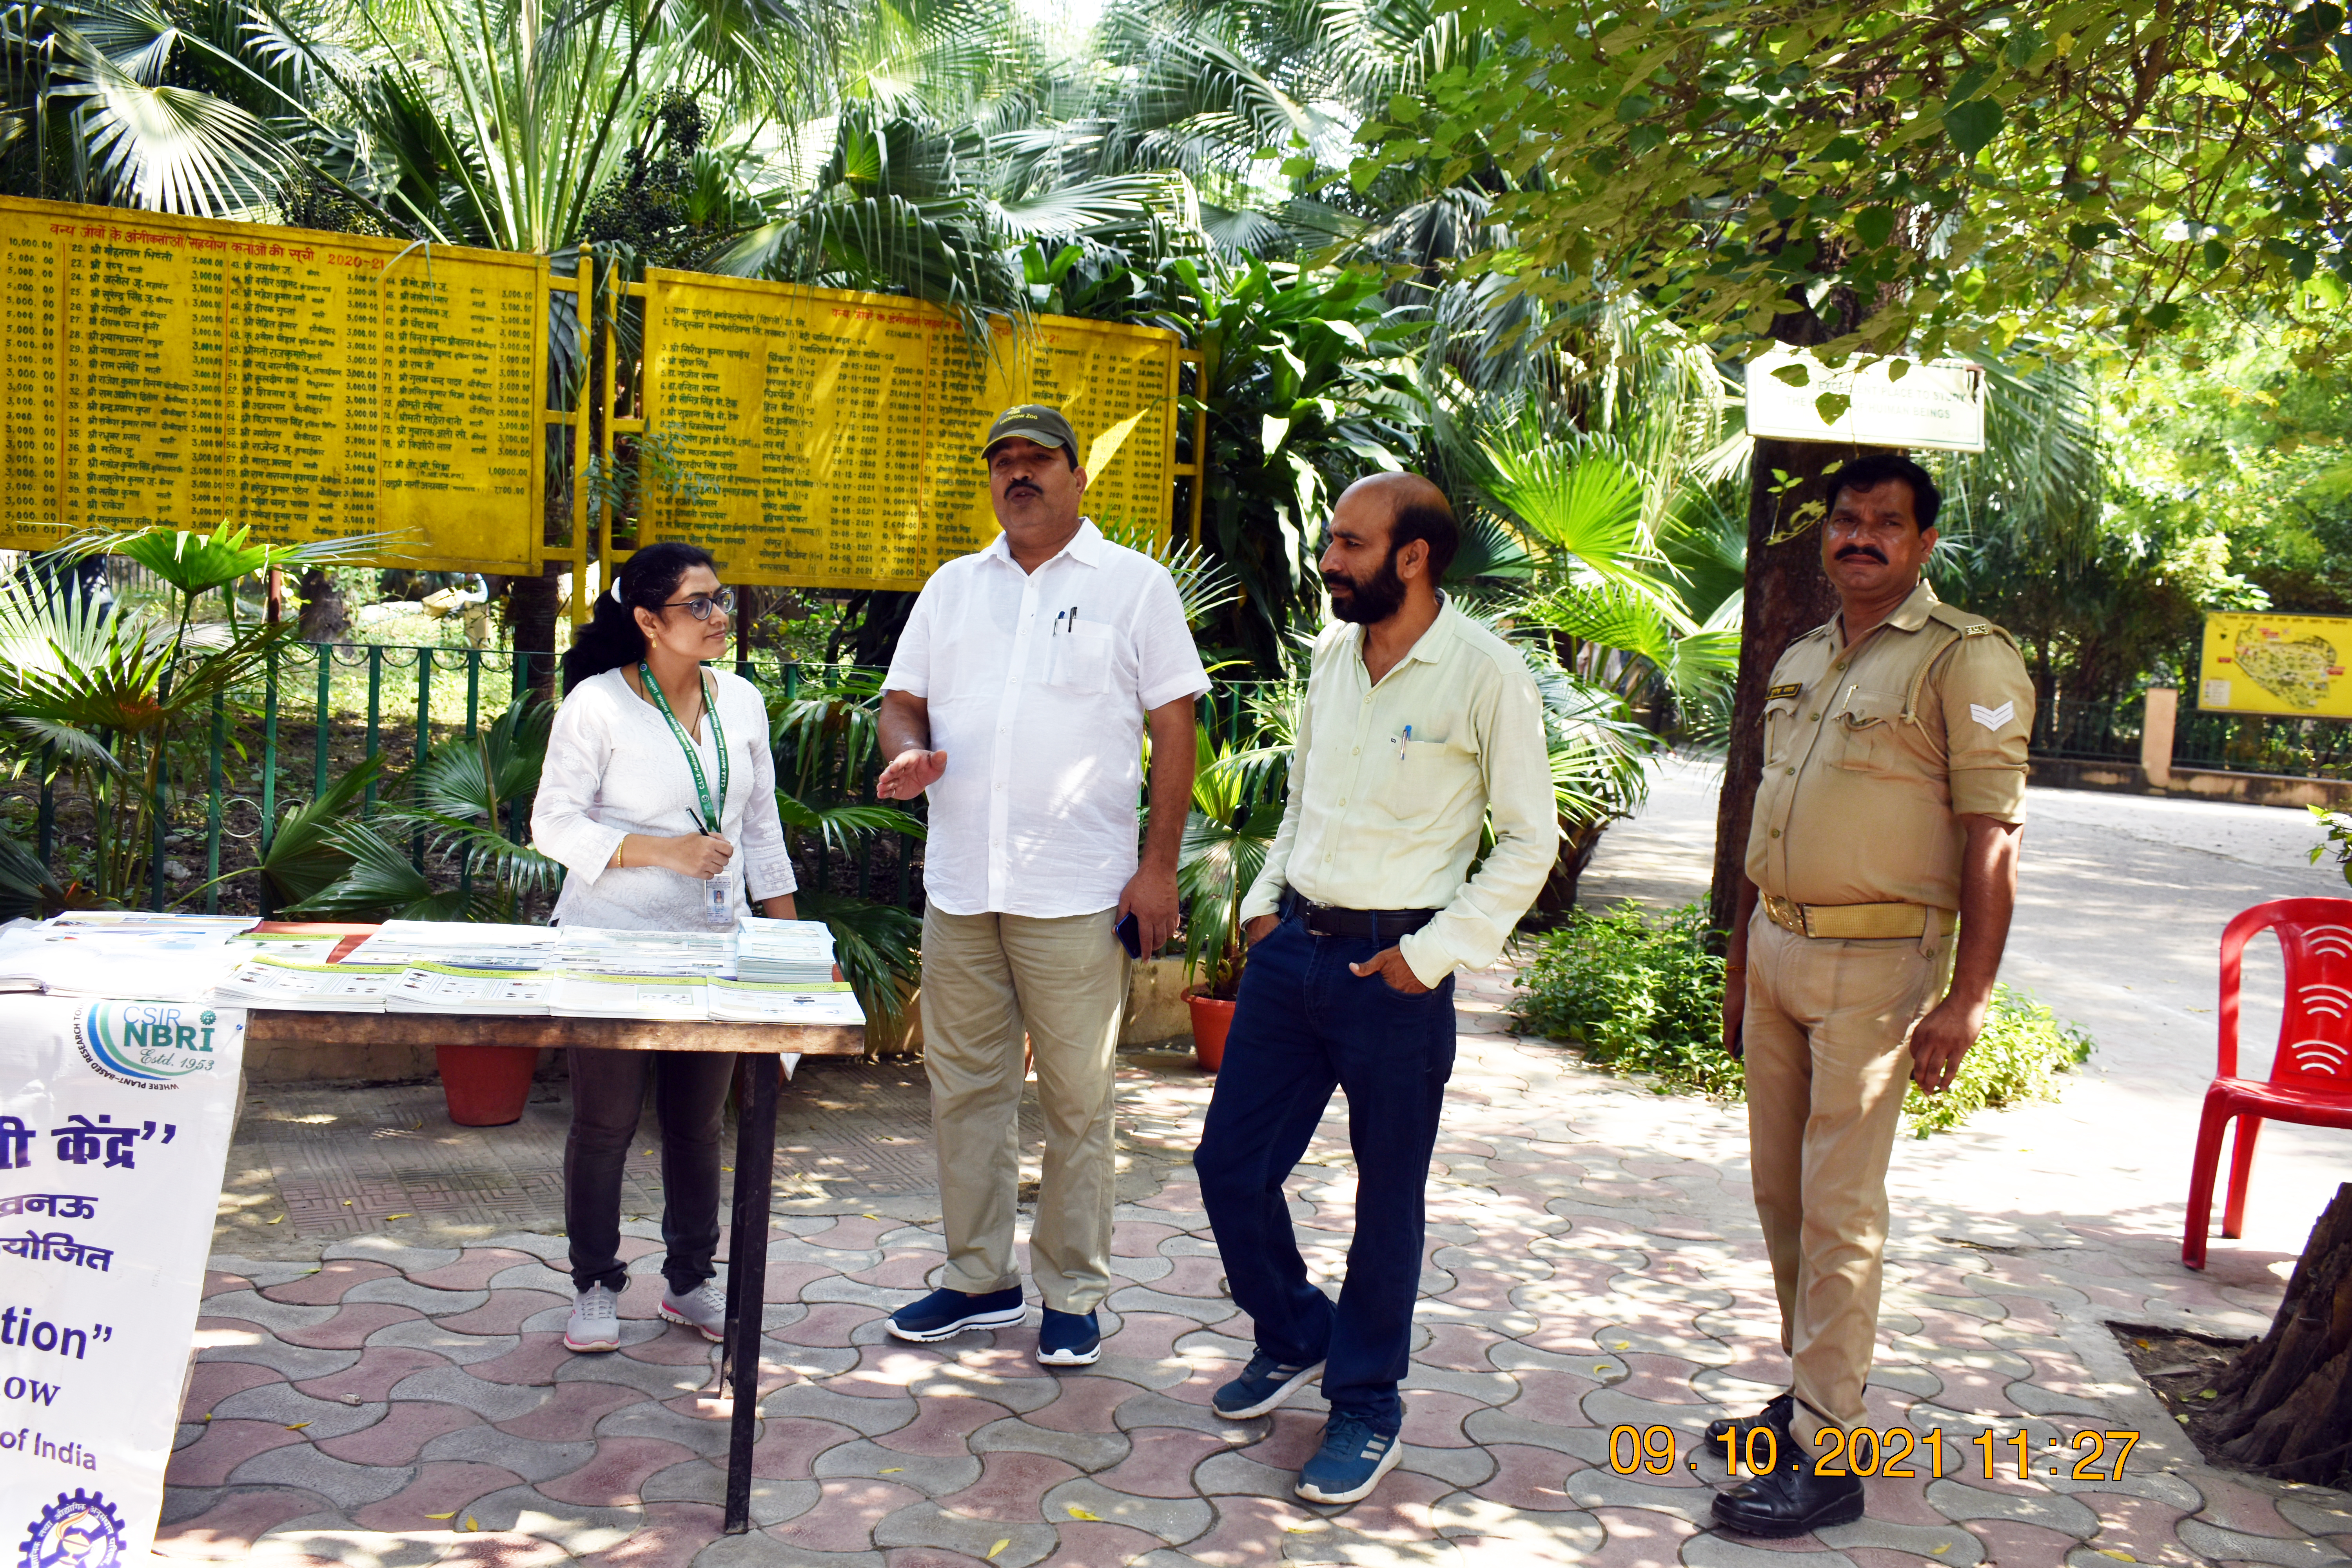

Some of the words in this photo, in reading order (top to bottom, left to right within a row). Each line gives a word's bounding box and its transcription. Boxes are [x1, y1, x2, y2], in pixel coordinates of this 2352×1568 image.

[50, 224, 76, 236] वन्य
[81, 225, 106, 240] जीवों
[111, 225, 122, 241] के
[269, 244, 283, 257] की
[289, 247, 314, 264] सूची
[328, 254, 385, 270] 2020-21
[91, 244, 101, 254] श्री
[91, 260, 101, 270] श्री
[90, 274, 100, 283] श्री
[90, 289, 100, 298] श्री
[243, 303, 253, 313] श्री
[244, 317, 254, 327] श्री
[1881, 386, 1913, 399] PLACE
[1916, 389, 1930, 399] TO
[1786, 396, 1806, 407] THE
[1913, 407, 1951, 419] BEINGS
[999, 413, 1025, 425] Lucknow
[646, 675, 659, 694] Lucknow
[666, 713, 680, 731] Research
[677, 732, 691, 751] Botanical
[123, 1006, 181, 1026] CSIR
[73, 1024, 93, 1063] RESEARCH
[124, 1022, 215, 1052] NBRI
[140, 1049, 174, 1067] Estd.
[180, 1057, 215, 1071] 1953
[91, 1063, 147, 1090] PLANT-BASED
[0, 1376, 61, 1406] ow
[0, 1428, 29, 1451] of
[34, 1432, 96, 1471] India
